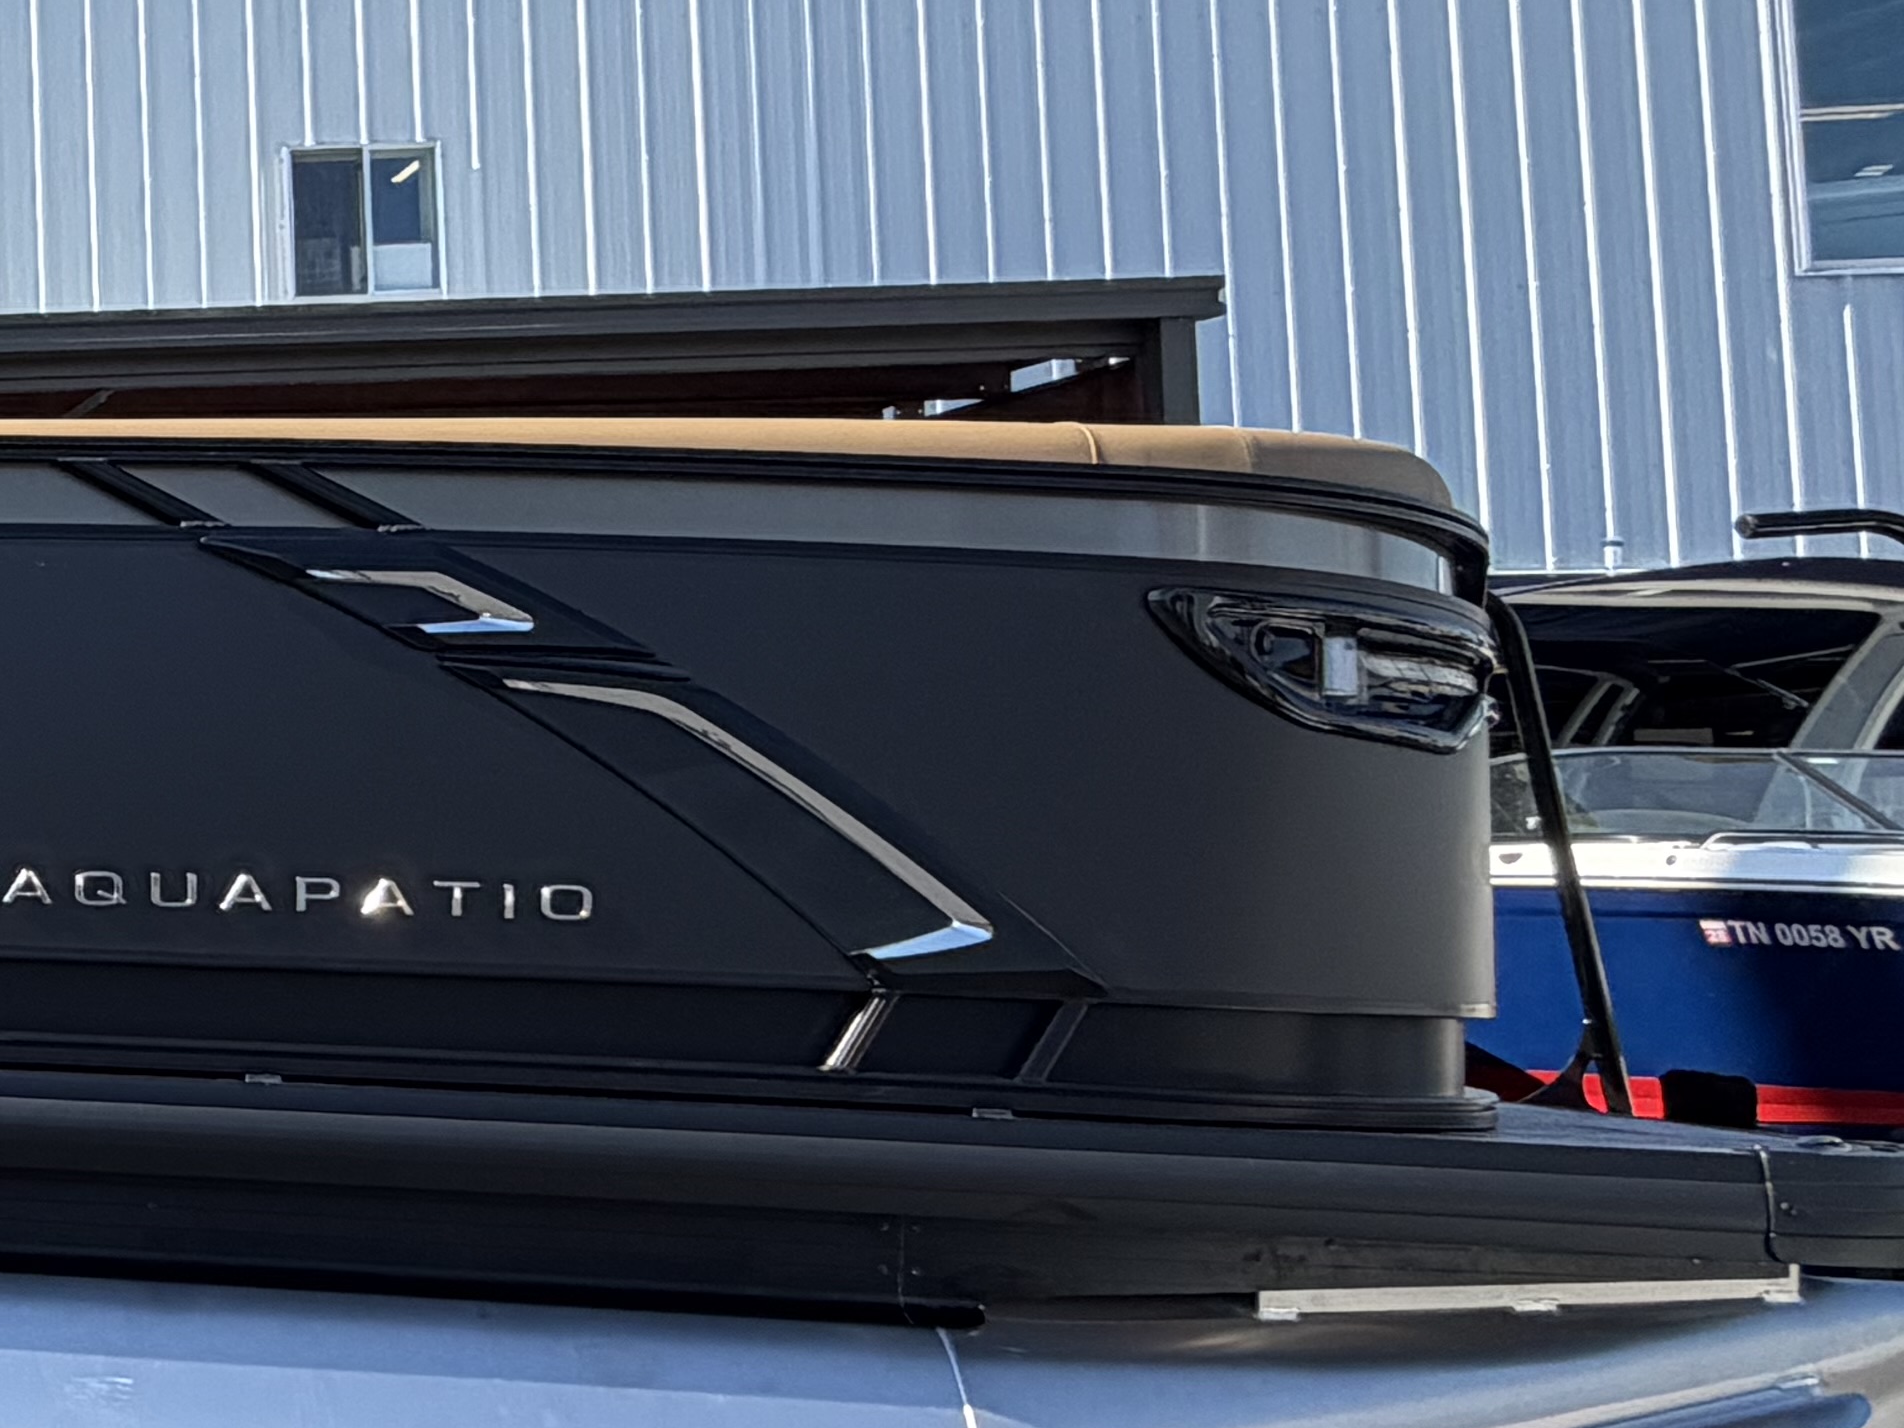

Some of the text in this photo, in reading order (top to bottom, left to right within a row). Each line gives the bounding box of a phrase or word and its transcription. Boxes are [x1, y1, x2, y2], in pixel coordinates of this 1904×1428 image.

[1, 867, 594, 921] AQUAPATIO
[1727, 919, 1902, 951] TN 0058 YR
